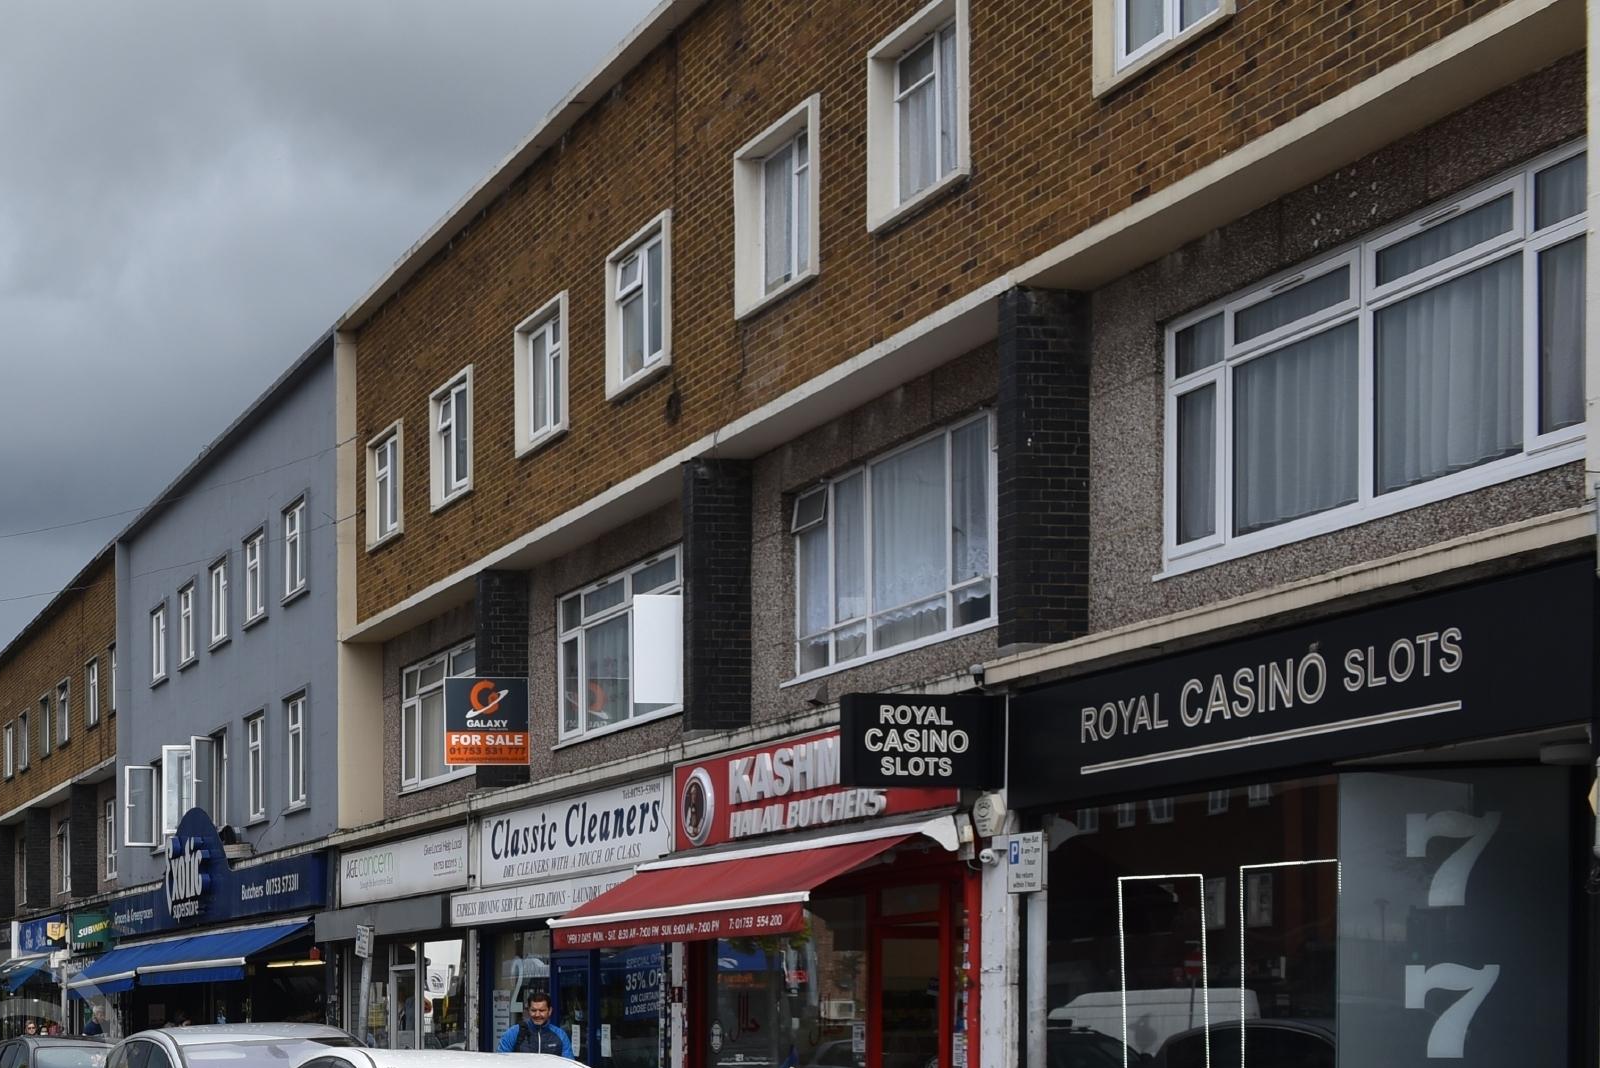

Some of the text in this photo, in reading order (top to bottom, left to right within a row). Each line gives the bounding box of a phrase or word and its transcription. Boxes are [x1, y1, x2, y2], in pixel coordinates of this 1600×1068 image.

[1081, 628, 1462, 743] ROYAL CASINO SLOTS
[466, 720, 508, 728] GALAXY
[880, 705, 953, 725] ROYAL
[452, 734, 523, 746] FOR SALE
[865, 728, 969, 753] CASINO
[729, 735, 840, 805] KASHM
[881, 756, 952, 777] SLOTS
[730, 788, 887, 838] HALAL BUTCHERS
[491, 800, 660, 860] Classic Cleaners
[503, 864, 515, 878] DRY
[517, 860, 549, 876] CLEANERS
[551, 856, 569, 871] WITH
[578, 849, 601, 866] TOUCH
[605, 848, 614, 861] OF
[617, 843, 642, 860] CLASS
[1011, 842, 1018, 863] P
[1406, 811, 1500, 907] 7
[242, 883, 263, 900] Butchers
[266, 877, 280, 895] 01753
[173, 900, 199, 923] superstore
[501, 896, 523, 912] SERVICE
[528, 892, 565, 910] ALTERATIONS
[78, 920, 109, 937] SUBWAY
[712, 920, 720, 932] PM
[735, 917, 753, 929] 01753
[756, 916, 769, 928] 554
[770, 914, 783, 926] 200
[626, 968, 661, 991] 35% OF
[1405, 963, 1500, 1058] 7
